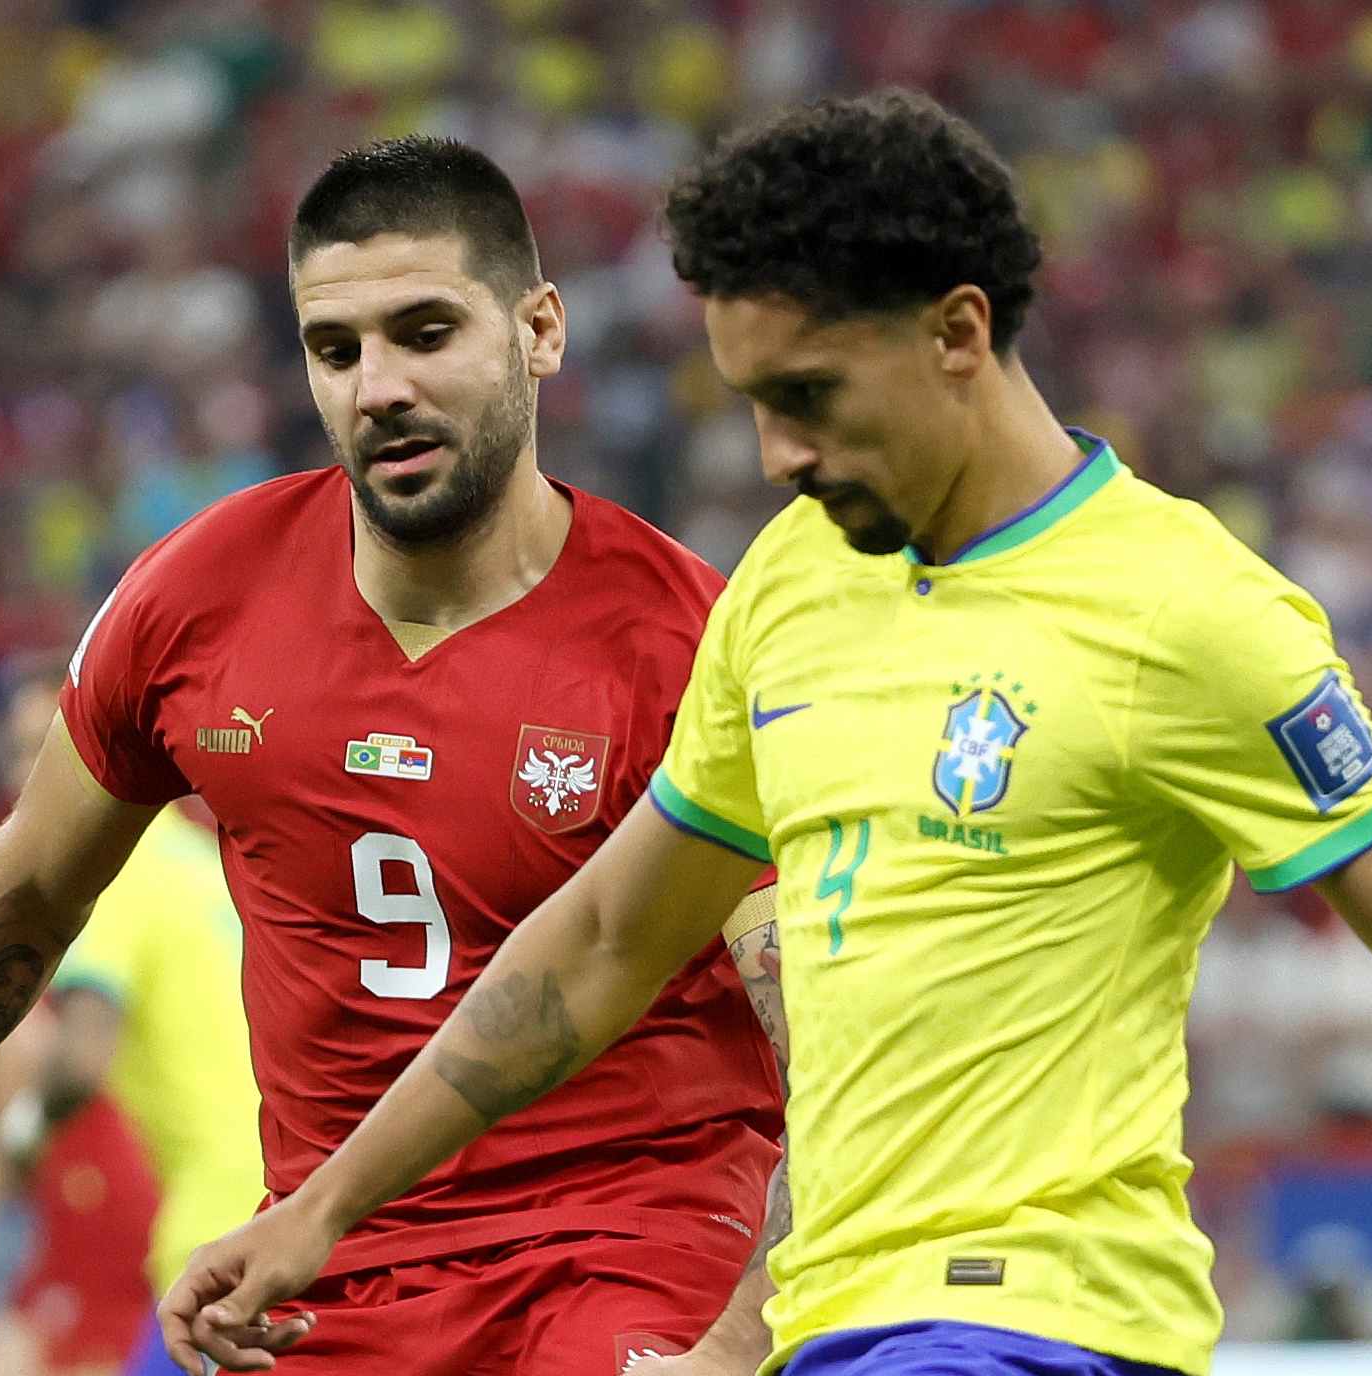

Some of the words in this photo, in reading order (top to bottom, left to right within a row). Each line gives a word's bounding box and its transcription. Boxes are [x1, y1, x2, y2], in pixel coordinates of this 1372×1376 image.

[196, 728, 252, 754] PUMA
[542, 734, 585, 753] СРБИЈА
[959, 738, 989, 757] CBF
[918, 815, 1008, 854] BRASIL
[817, 818, 870, 955] 4
[351, 832, 451, 1000] 9
